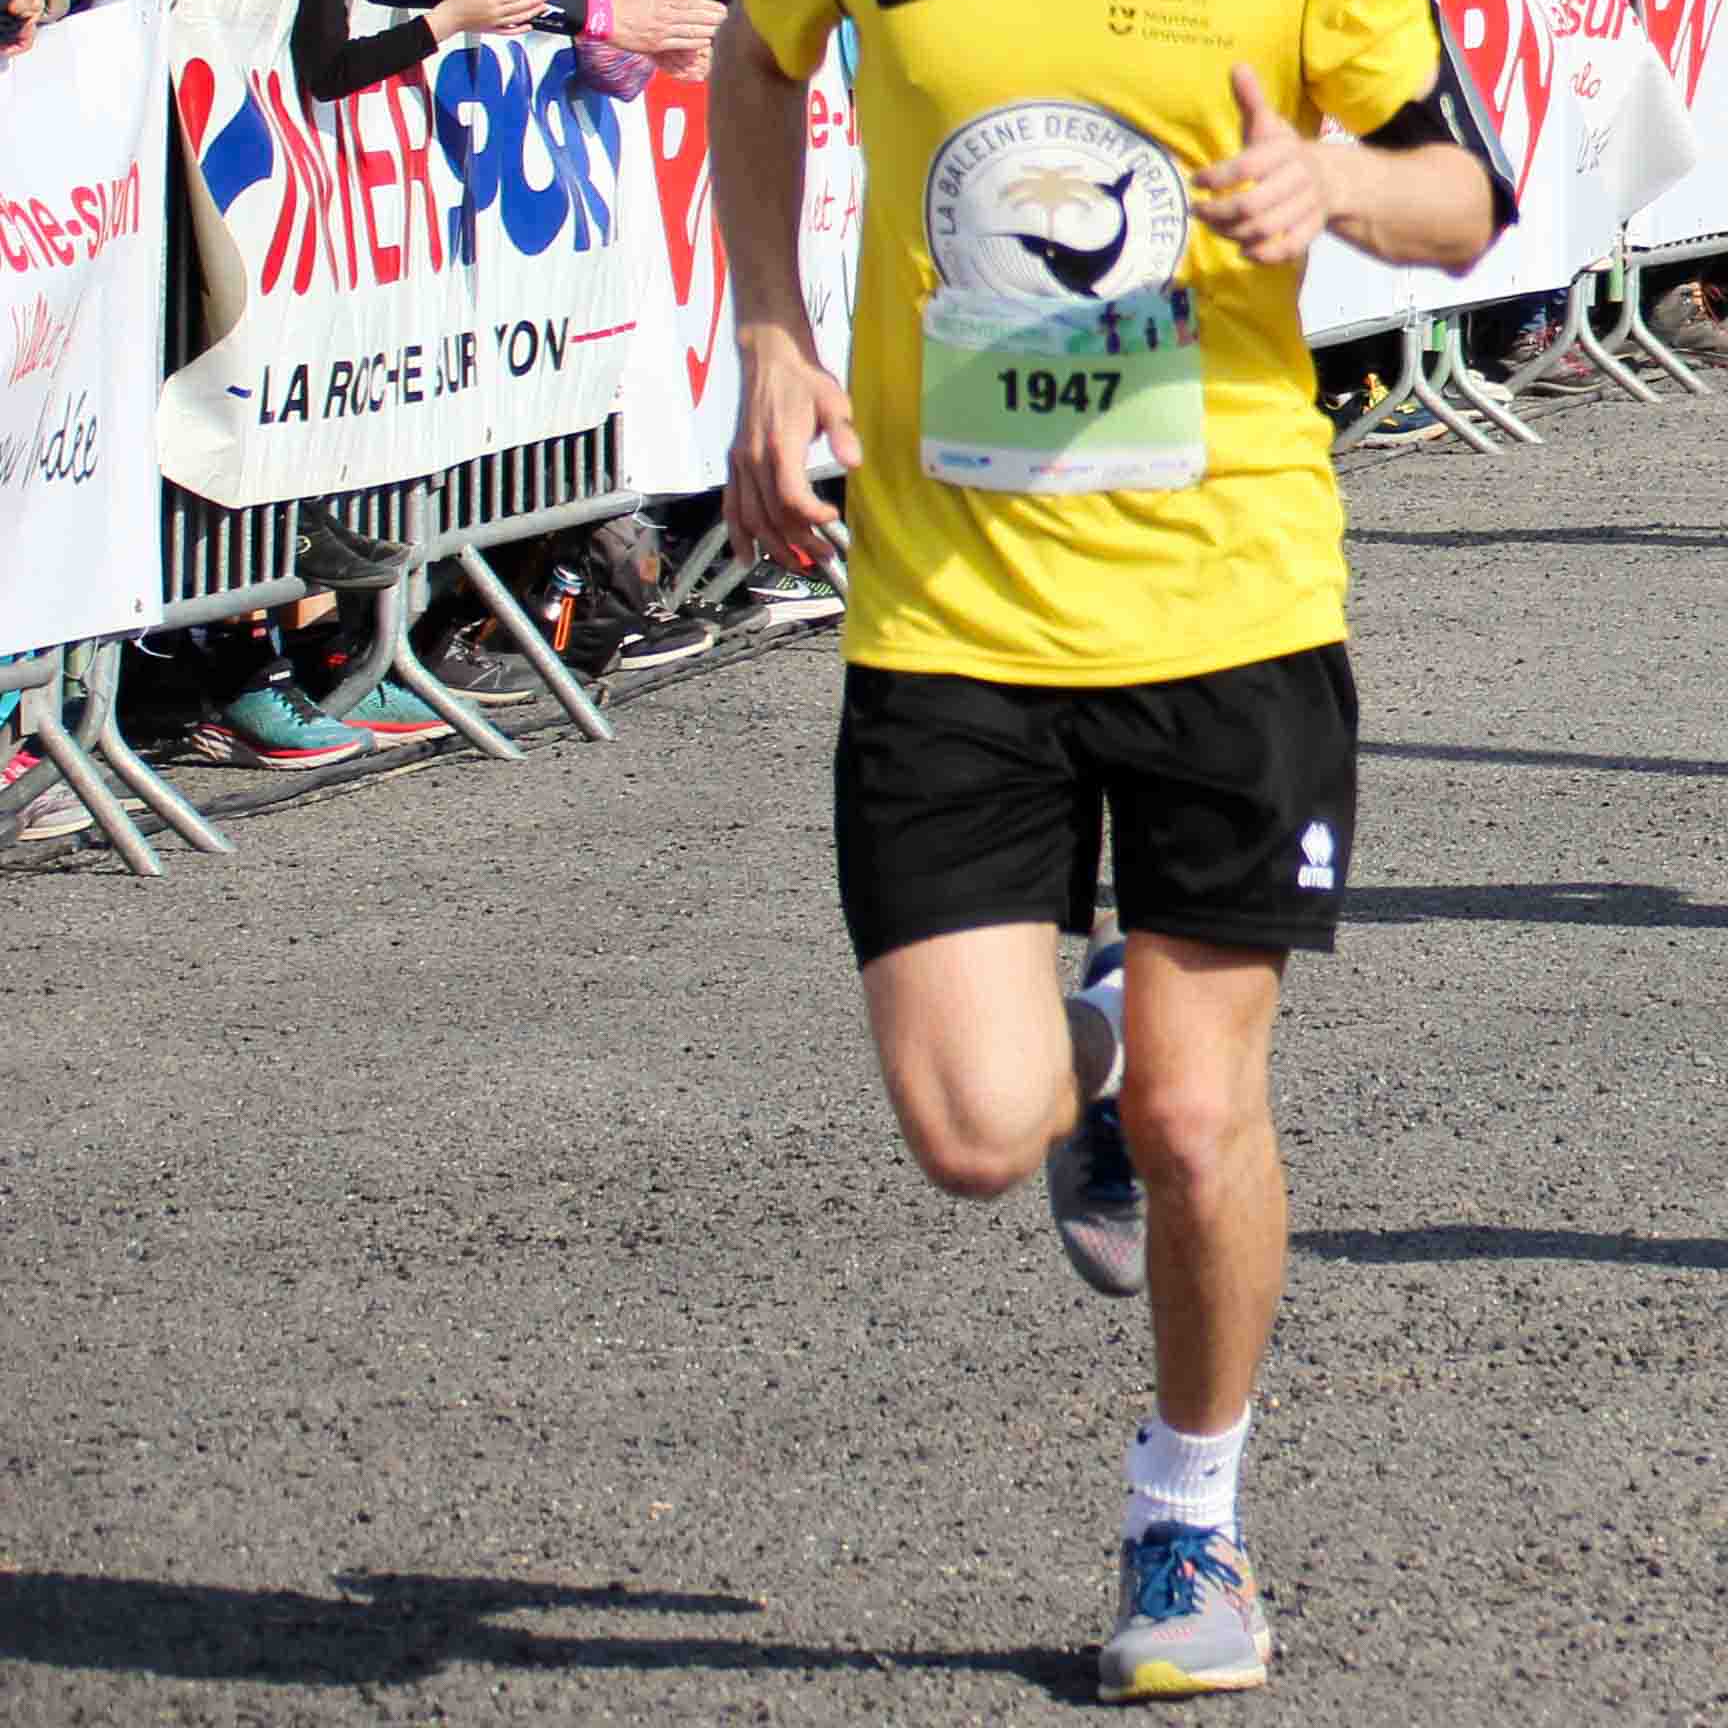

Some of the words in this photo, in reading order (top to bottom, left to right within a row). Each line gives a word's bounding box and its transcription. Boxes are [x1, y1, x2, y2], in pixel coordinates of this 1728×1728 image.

[937, 115, 1035, 202] BALEINE
[936, 203, 956, 236] LA
[258, 364, 309, 425] LA
[997, 368, 1123, 413] 1947
